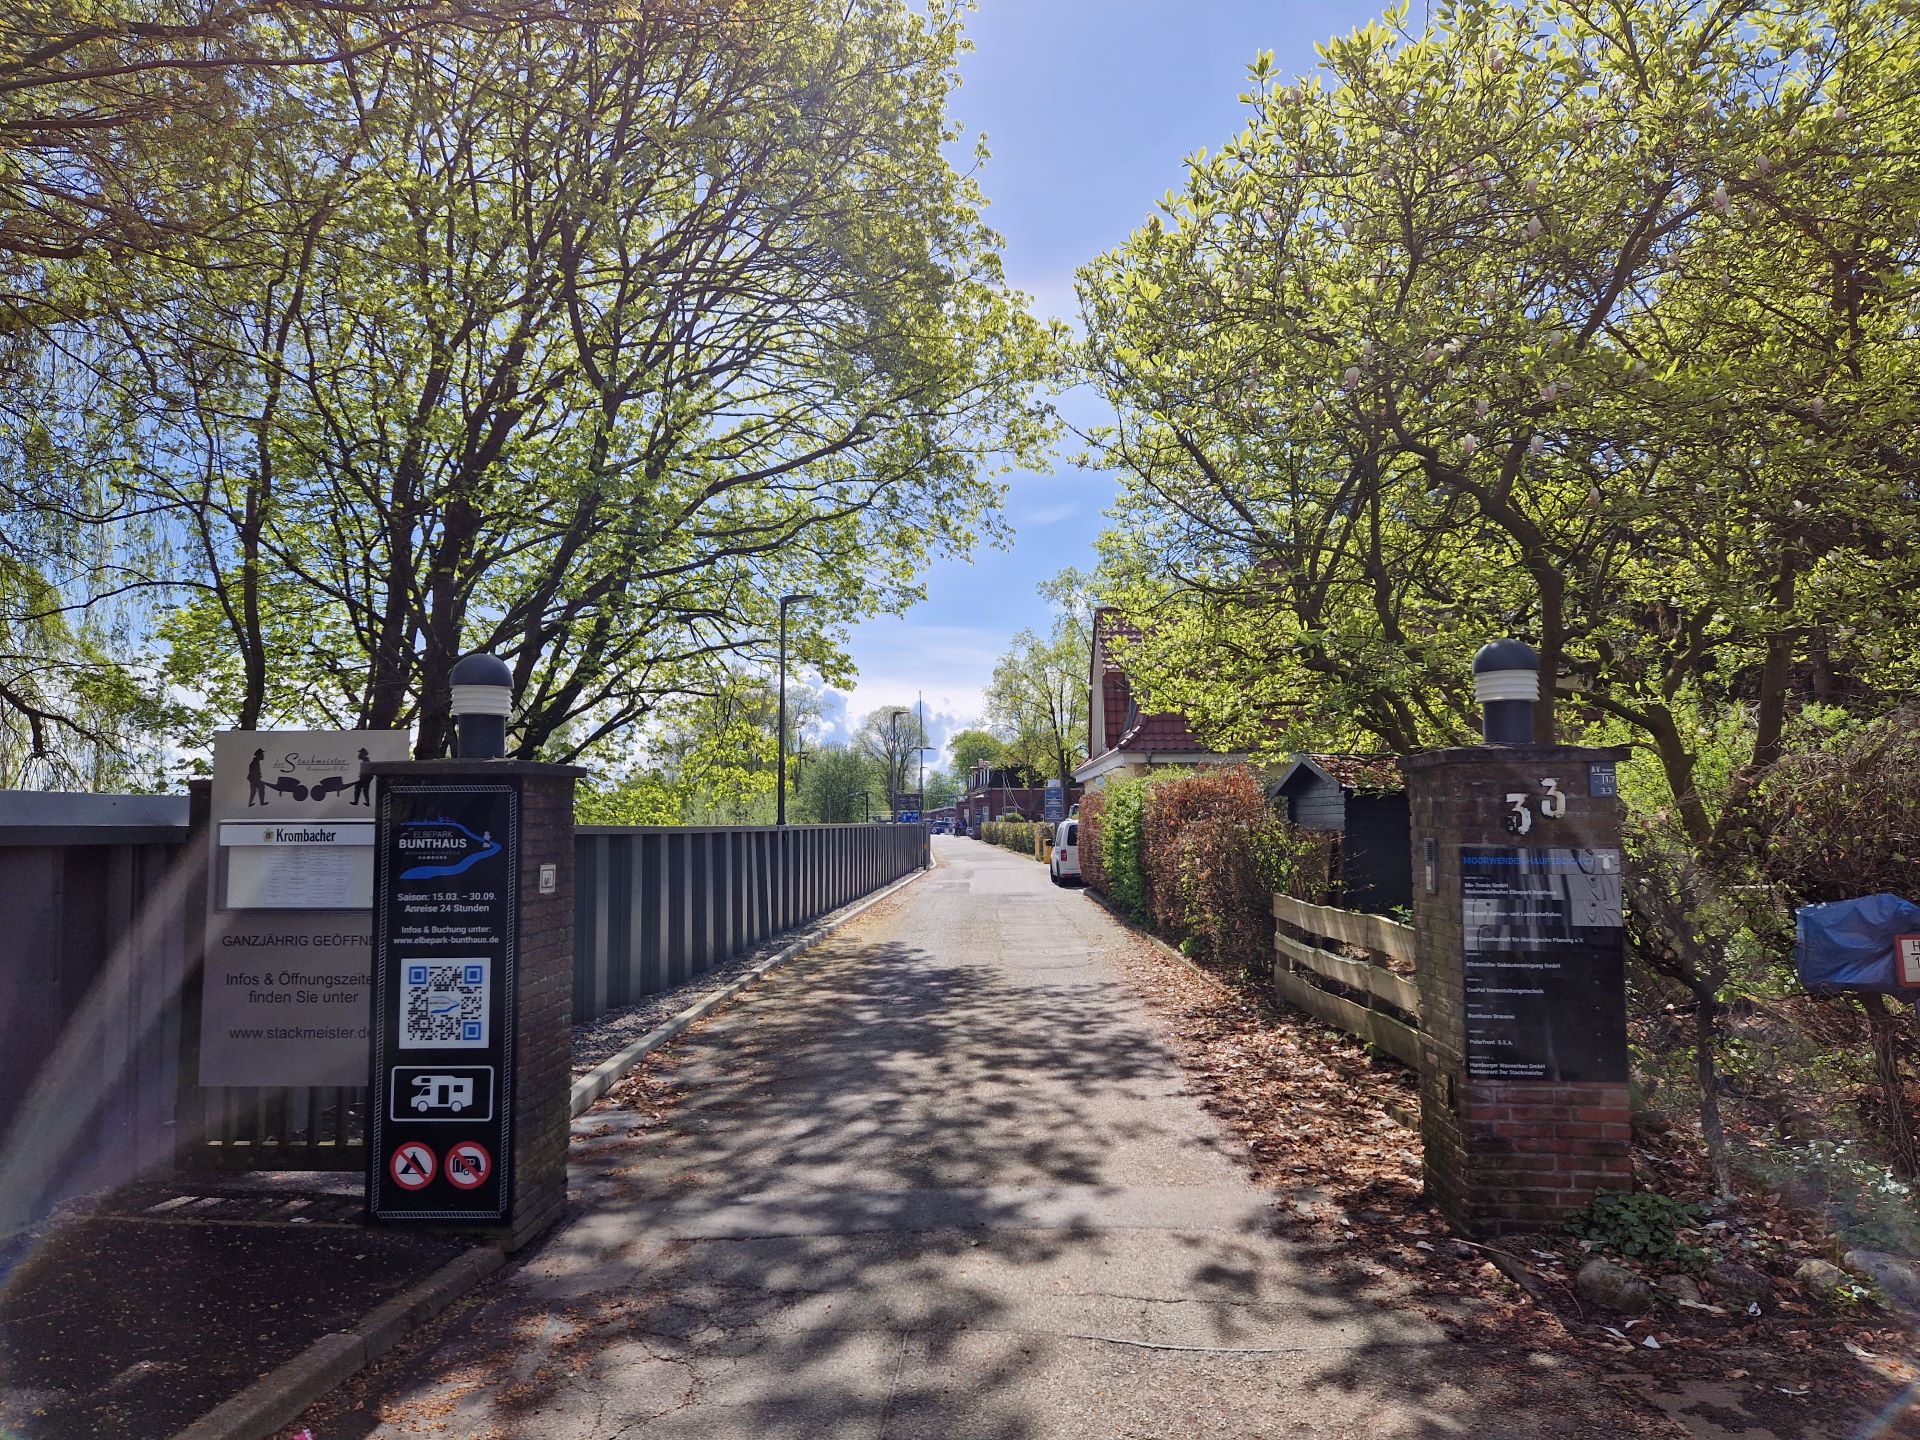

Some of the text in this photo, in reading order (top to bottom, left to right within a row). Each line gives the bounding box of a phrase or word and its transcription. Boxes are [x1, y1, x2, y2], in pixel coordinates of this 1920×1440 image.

[1506, 777, 1566, 835] 33
[276, 828, 337, 842] Krombacher
[413, 831, 453, 839] ELBEPARK
[398, 838, 467, 849] BUNTHAUS
[1463, 856, 1521, 865] MOORWERDER
[397, 893, 430, 901] Saison:
[431, 892, 459, 901] 15.03.
[469, 892, 497, 900] 30.09.
[404, 903, 490, 913] Anreise 24 Stunden
[431, 925, 466, 935] Buchung
[222, 934, 308, 947] GANZJÄHRIG
[392, 936, 499, 945] www.elbepark-bunthaus.de
[226, 973, 259, 986] Infos
[264, 973, 274, 986] &
[249, 991, 358, 1004] finden Sie unter
